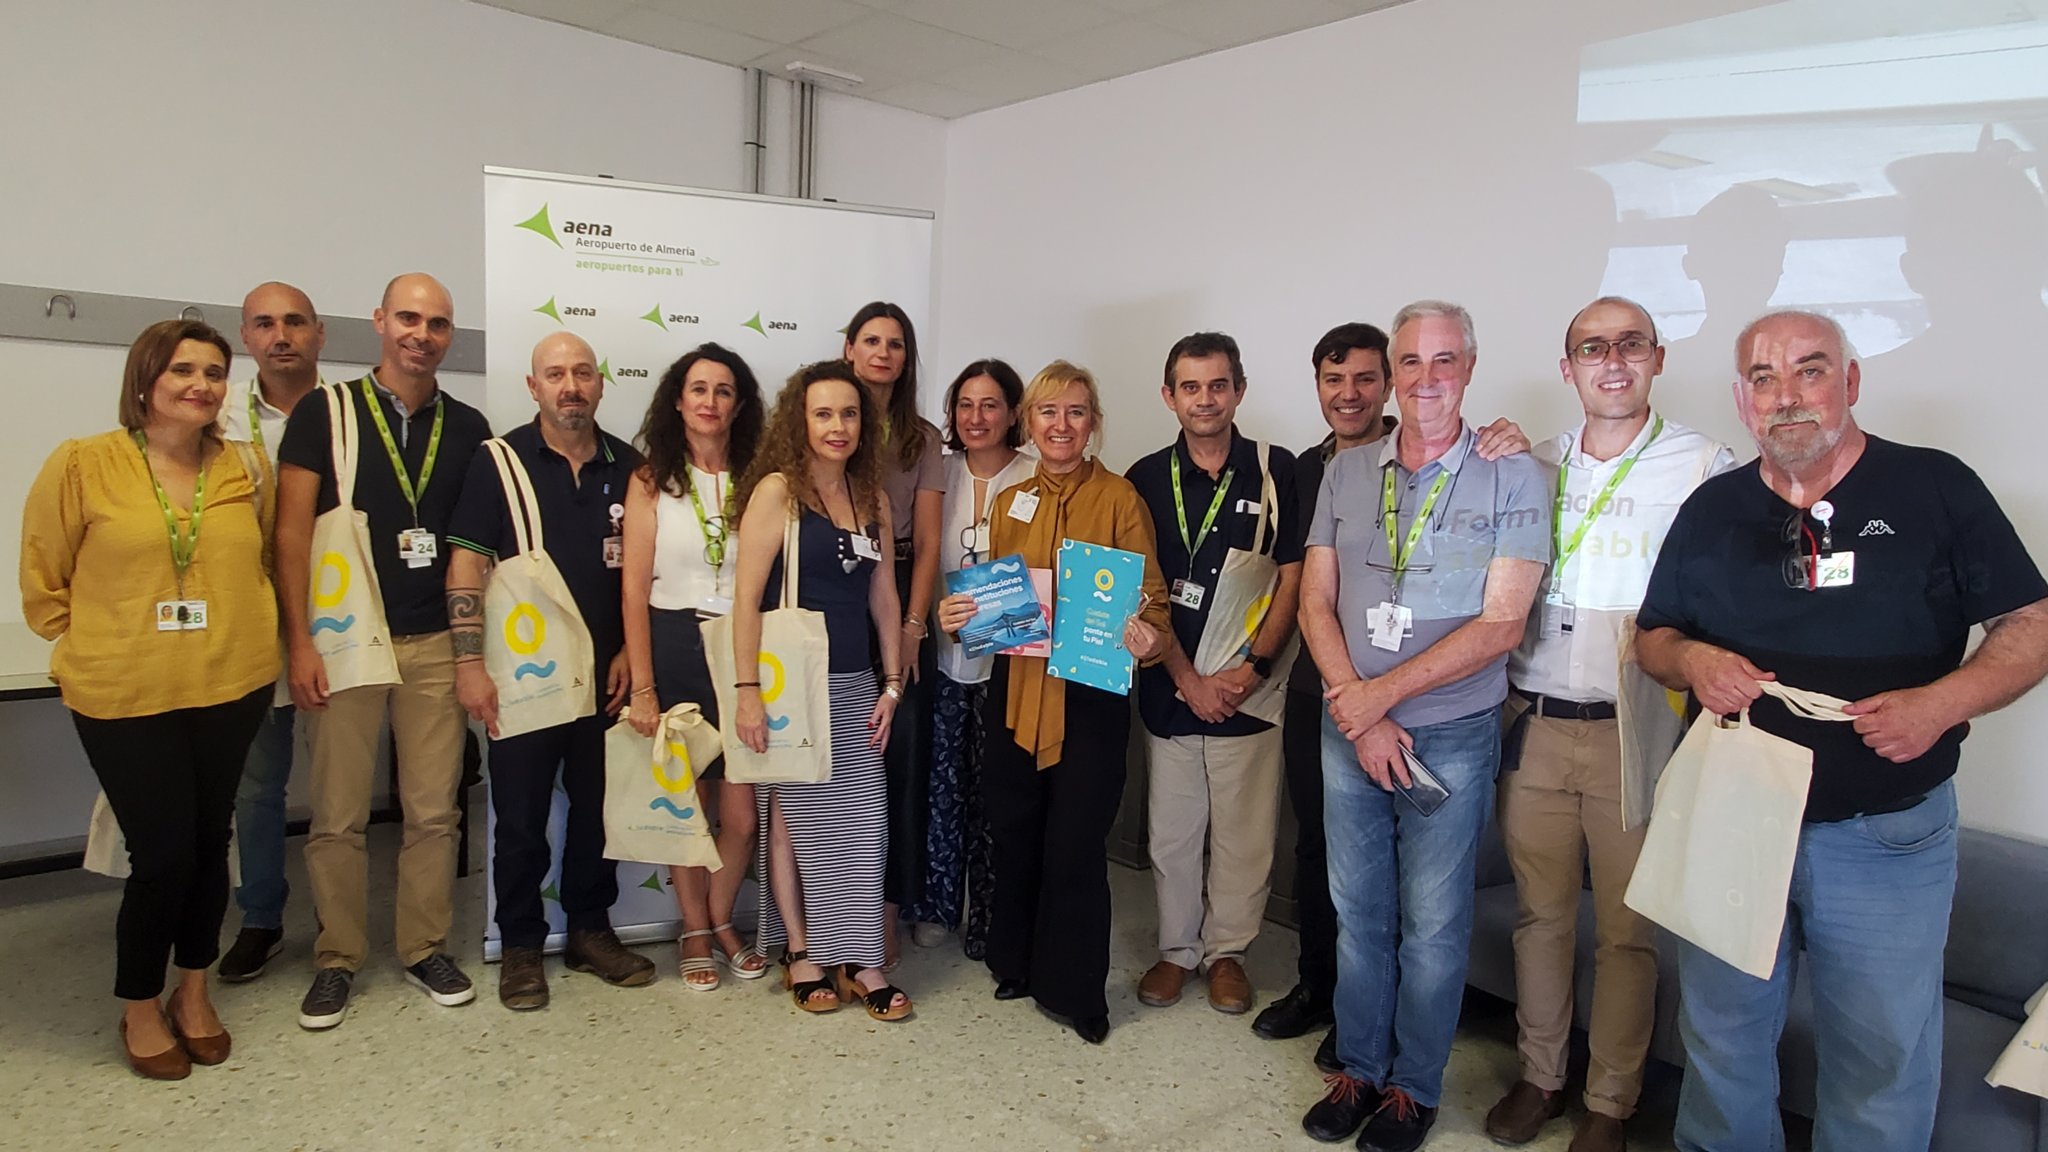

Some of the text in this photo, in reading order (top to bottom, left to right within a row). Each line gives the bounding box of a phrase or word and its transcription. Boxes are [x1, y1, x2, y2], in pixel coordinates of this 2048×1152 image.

[563, 220, 613, 237] aena
[575, 237, 696, 257] Aeropuerto de Almería
[575, 259, 684, 277] aeropuertos para ti
[564, 306, 597, 317] aena
[668, 313, 700, 324] aena
[768, 320, 797, 331] aena
[617, 367, 648, 378] aena
[417, 543, 434, 554] 24
[1823, 565, 1849, 580] 28
[973, 585, 1023, 603] nstituciones
[1184, 592, 1200, 605] 28
